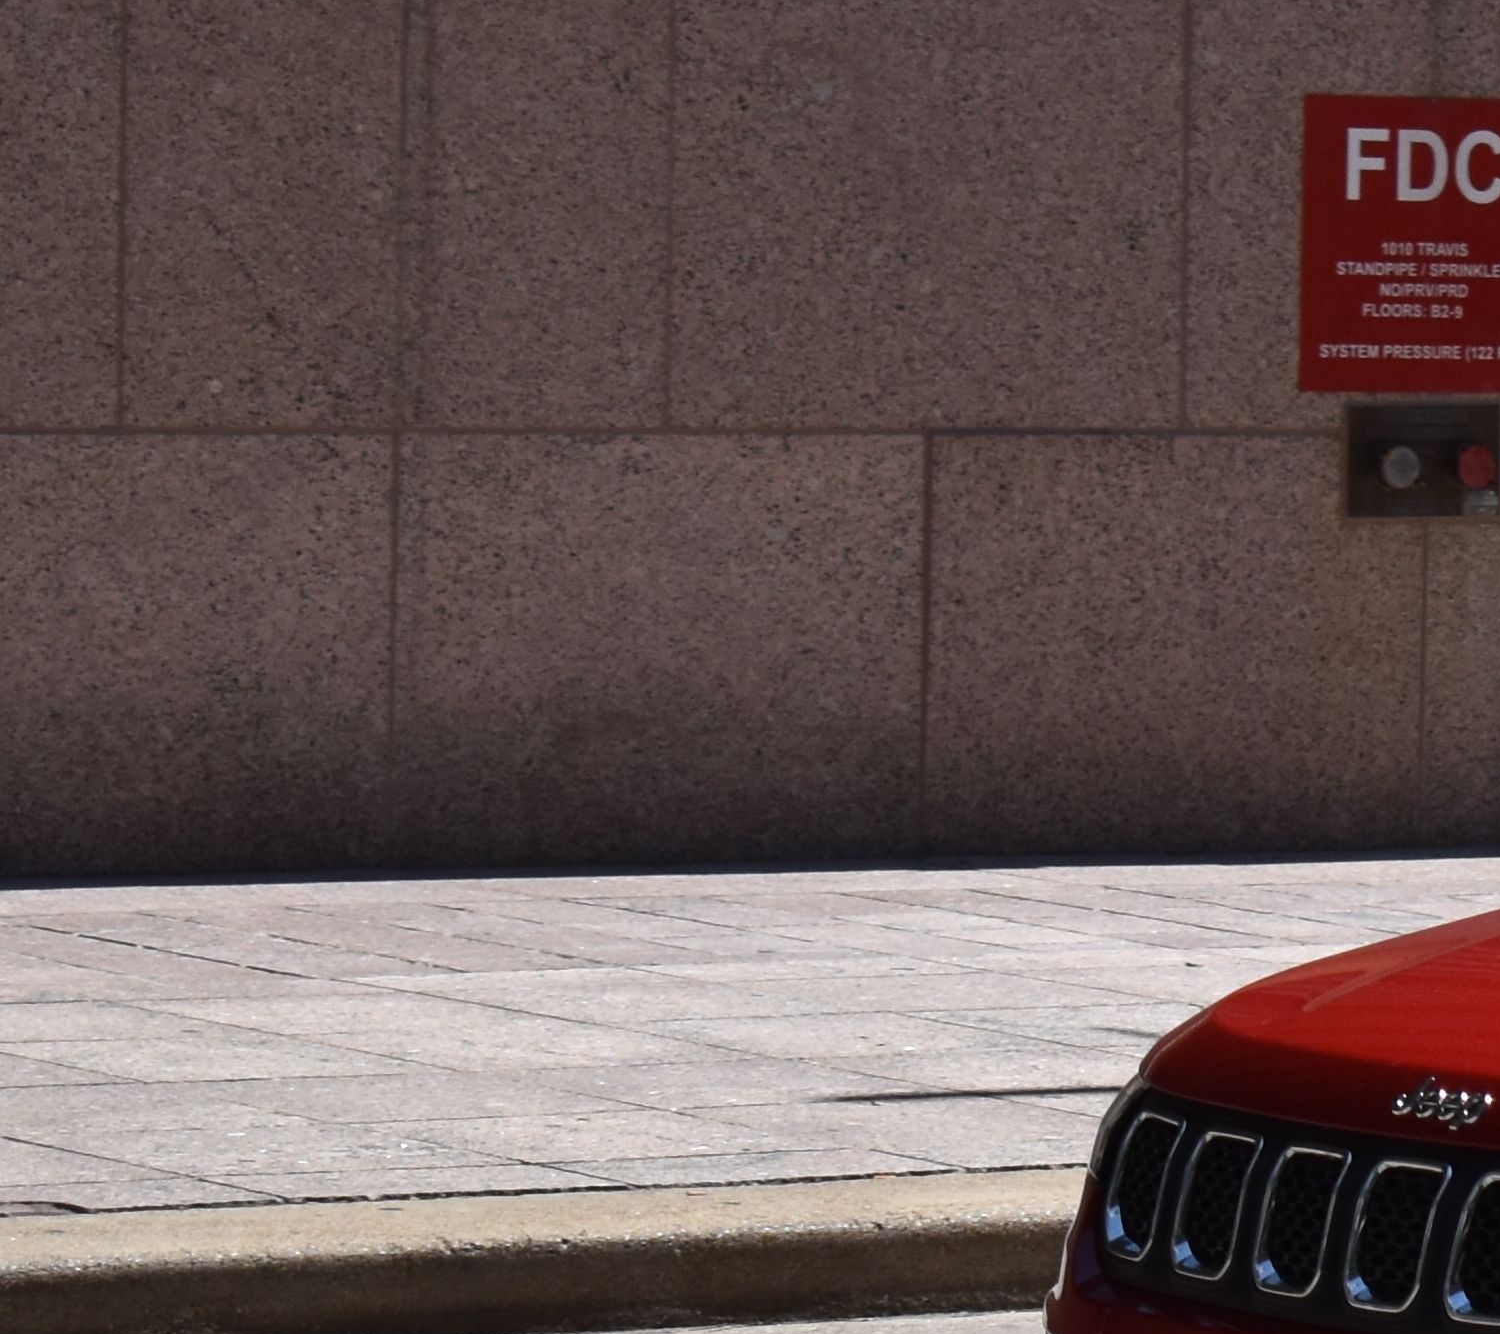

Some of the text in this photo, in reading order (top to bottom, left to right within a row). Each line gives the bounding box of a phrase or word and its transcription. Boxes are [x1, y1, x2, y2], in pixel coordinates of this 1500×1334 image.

[1381, 242, 1469, 257] 1010 TRAVIS
[1336, 262, 1417, 277] STANDPIPE
[1362, 303, 1427, 317] FLOORS:
[1319, 344, 1380, 359] SYSTEM
[1382, 344, 1462, 360] PRESSURE
[1391, 1076, 1494, 1131] Jeep
